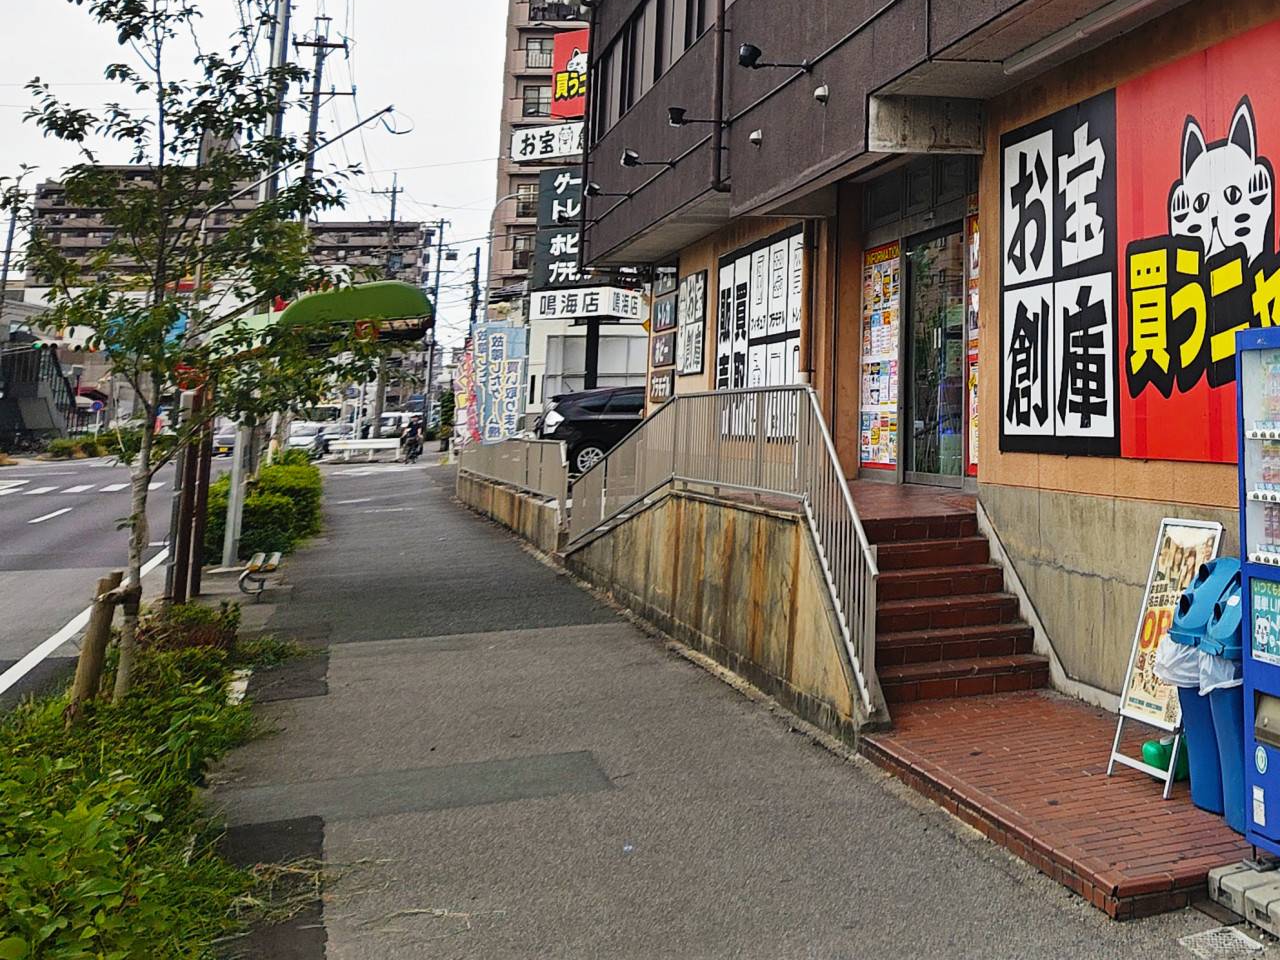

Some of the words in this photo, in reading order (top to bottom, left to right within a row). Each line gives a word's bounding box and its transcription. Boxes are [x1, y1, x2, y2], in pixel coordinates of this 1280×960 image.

[555, 71, 588, 99] 買うニ
[553, 172, 583, 195] ゲー
[552, 198, 581, 221] トレ
[1007, 121, 1105, 276] お宝
[549, 232, 580, 257] ホビ
[539, 292, 600, 317] 鳴海店
[1005, 285, 1108, 429] 創庫
[1139, 609, 1173, 649] OP
